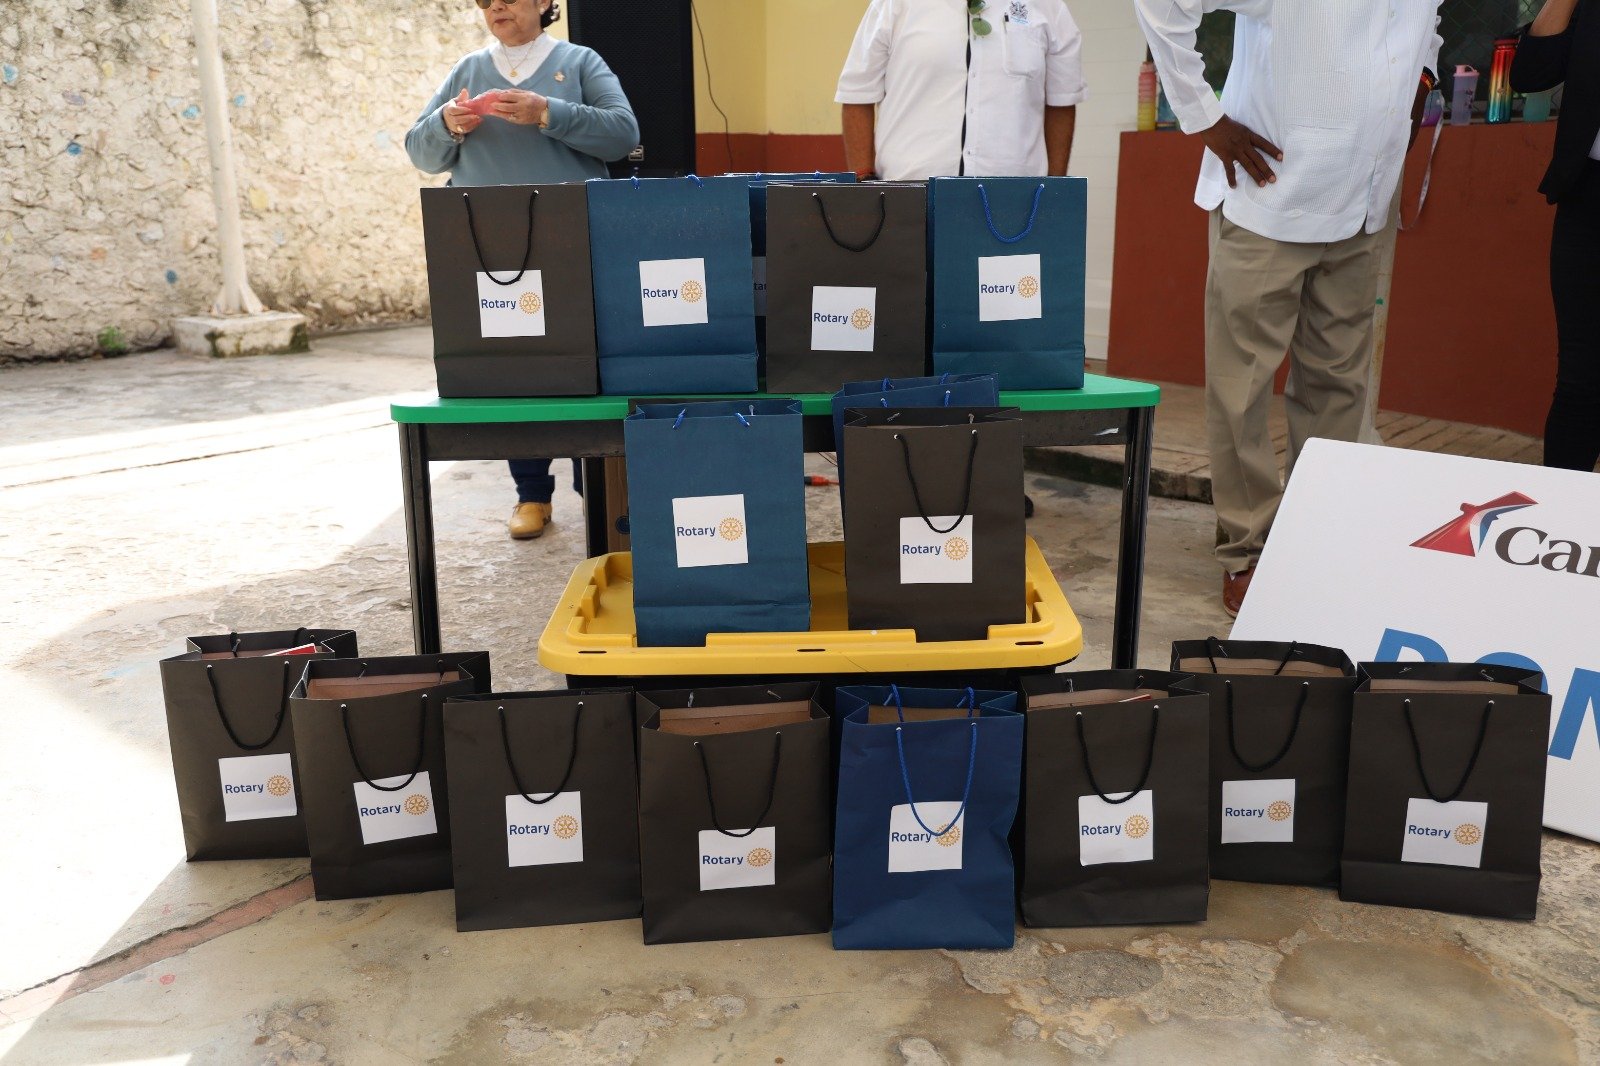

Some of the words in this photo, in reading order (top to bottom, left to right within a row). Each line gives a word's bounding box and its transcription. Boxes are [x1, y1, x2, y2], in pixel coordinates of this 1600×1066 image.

[643, 287, 678, 299] Rotary
[981, 283, 1015, 295] Rotary
[481, 299, 516, 310] Rotary
[814, 313, 848, 325] Rotary
[677, 525, 715, 537] Rotary
[902, 544, 941, 556] Rotary
[225, 783, 263, 794] Rotary
[361, 804, 401, 817] Rotary
[1225, 807, 1264, 818] Rotary
[509, 824, 550, 836] Rotary
[1081, 824, 1122, 836] Rotary
[1408, 825, 1450, 838] Rotary
[891, 831, 932, 843] Rotary
[703, 855, 743, 866] Rotary
